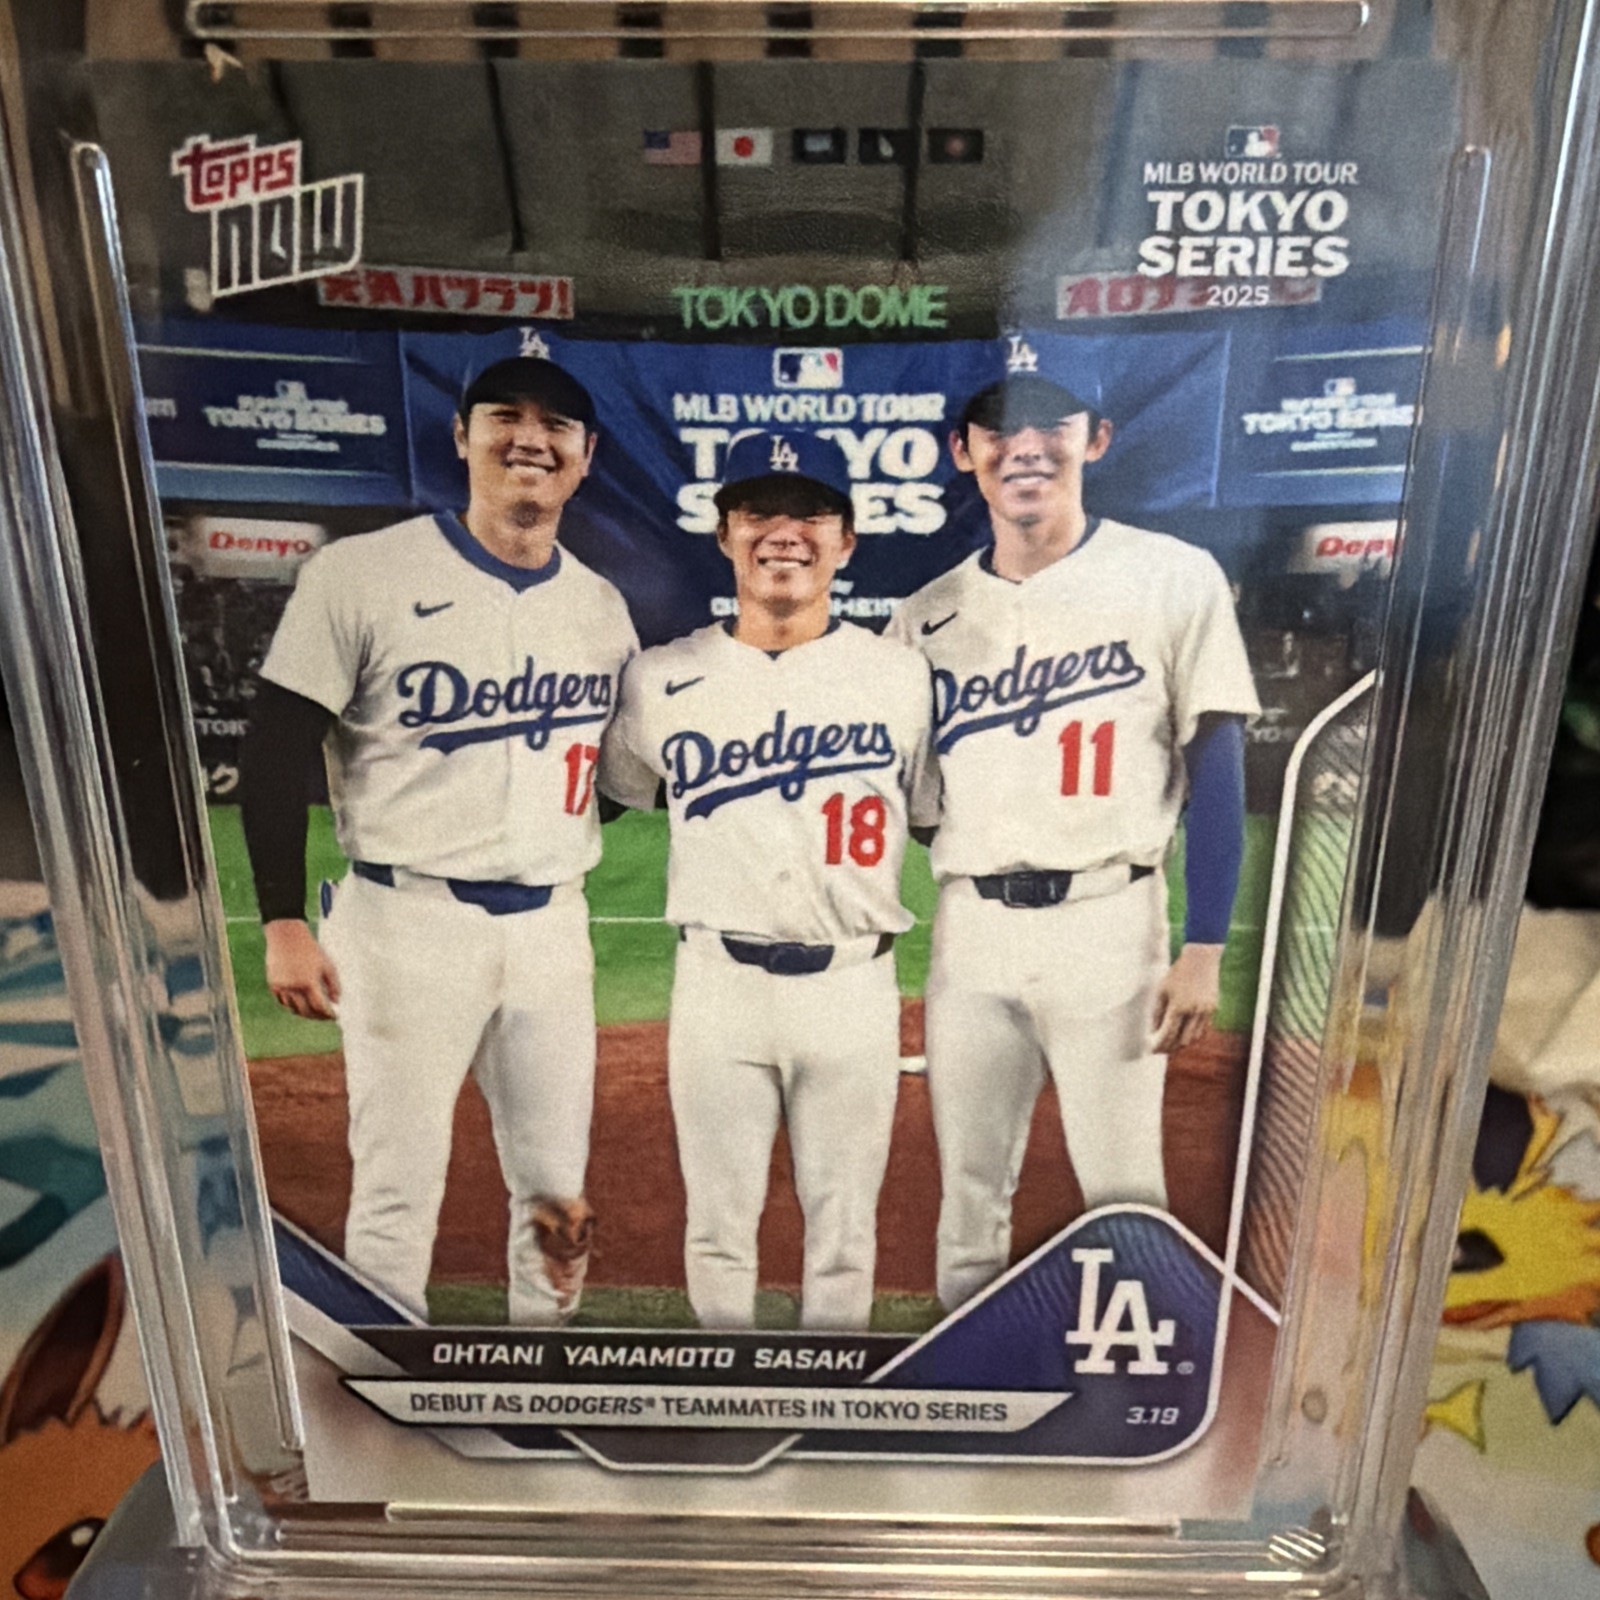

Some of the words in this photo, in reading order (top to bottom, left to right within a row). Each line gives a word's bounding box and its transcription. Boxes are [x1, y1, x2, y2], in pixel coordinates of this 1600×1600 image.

[174, 136, 302, 212] topps
[1143, 162, 1194, 185] MLB
[1198, 162, 1287, 184] WORLD
[1293, 161, 1359, 185] TOUR
[1147, 190, 1349, 232] TOKYO
[1137, 236, 1350, 278] SERIES
[672, 284, 819, 329] TOKYO
[825, 284, 949, 329] DOME
[1206, 285, 1270, 307] 2025
[672, 392, 739, 422] MLB
[742, 393, 856, 423] WORLD
[858, 392, 946, 422] TOUR
[679, 426, 939, 480] TYO
[769, 434, 800, 473] LA
[676, 482, 948, 535] SES
[564, 742, 600, 816] 17
[662, 709, 896, 821] Dodgers
[1058, 720, 1116, 797] 11
[821, 791, 887, 867] 18
[1065, 1247, 1176, 1376] LA
[433, 1343, 545, 1365] OHTANI
[563, 1346, 735, 1368] YAMAMOTO
[753, 1348, 867, 1371] SASAKI
[410, 1393, 487, 1413] DEBUT
[492, 1394, 523, 1413] AS
[662, 1396, 806, 1419] TEAMMATES
[812, 1400, 836, 1418] IN
[842, 1400, 920, 1420] TOKYO
[926, 1402, 1008, 1422] SERIES
[1125, 1406, 1180, 1427] 3.19
